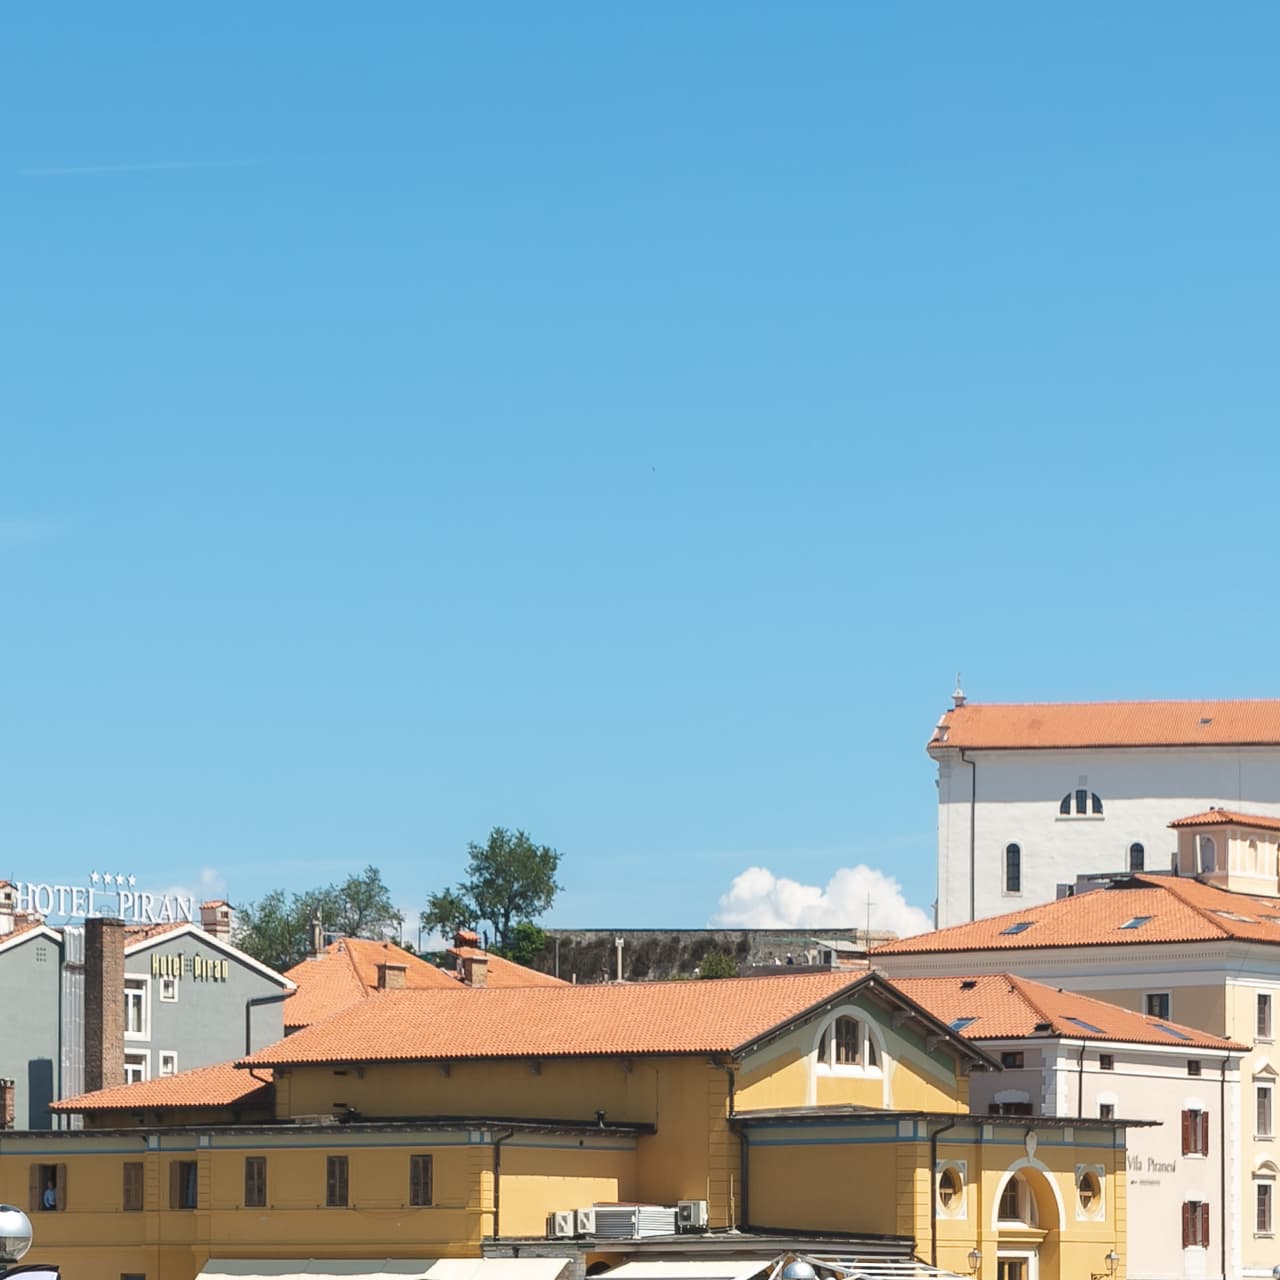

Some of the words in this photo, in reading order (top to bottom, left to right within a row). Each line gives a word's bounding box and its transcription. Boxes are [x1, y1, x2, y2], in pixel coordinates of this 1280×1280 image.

[14, 881, 101, 919] HOTEL
[117, 890, 194, 924] PIRAN
[151, 951, 186, 979] Hotel
[193, 952, 229, 983] Piran
